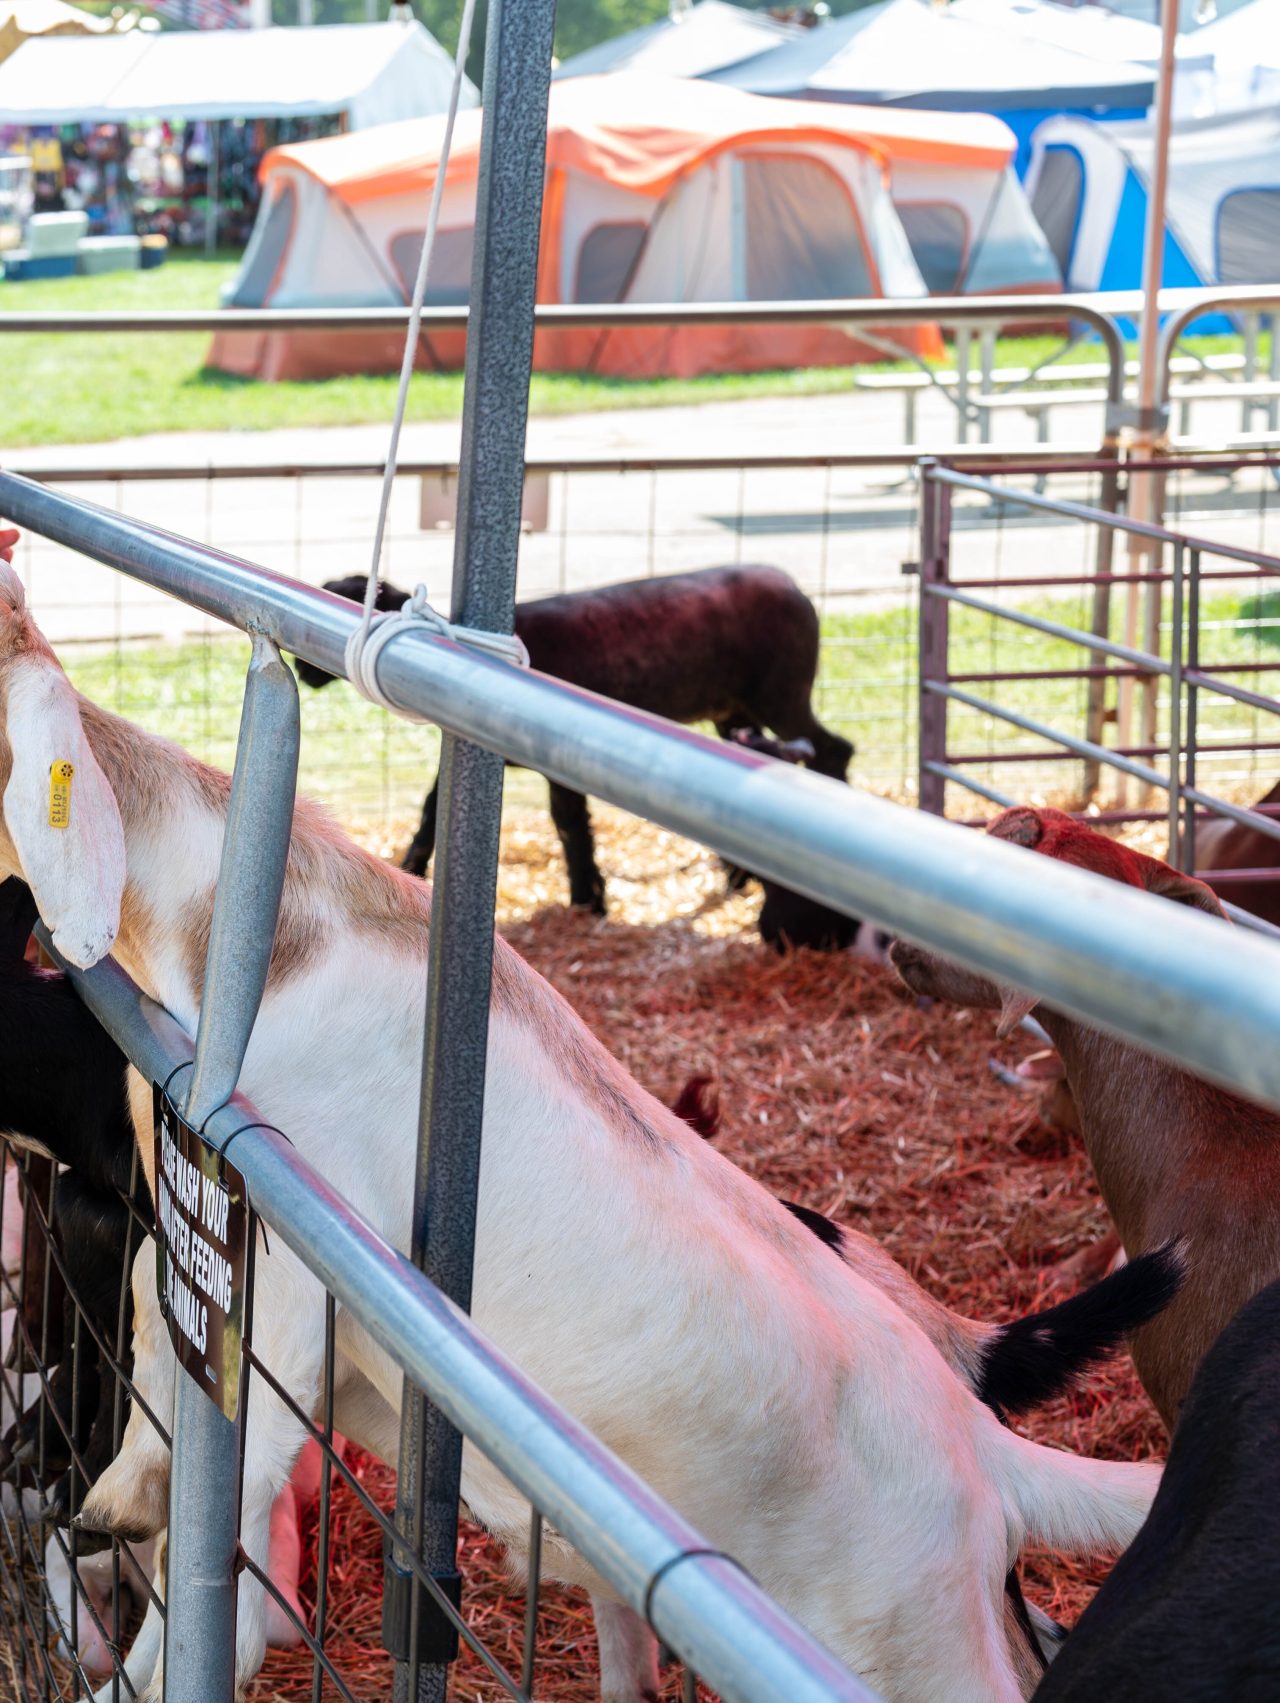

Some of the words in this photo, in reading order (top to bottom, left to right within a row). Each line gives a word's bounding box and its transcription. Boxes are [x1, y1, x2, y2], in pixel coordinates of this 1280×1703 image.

[52, 794, 62, 823] 0113
[176, 1149, 200, 1218] WASH
[201, 1174, 229, 1246] YOUR
[170, 1203, 190, 1273] AFTER
[191, 1230, 232, 1314] FEEDING
[174, 1271, 208, 1356] ANIMALS
